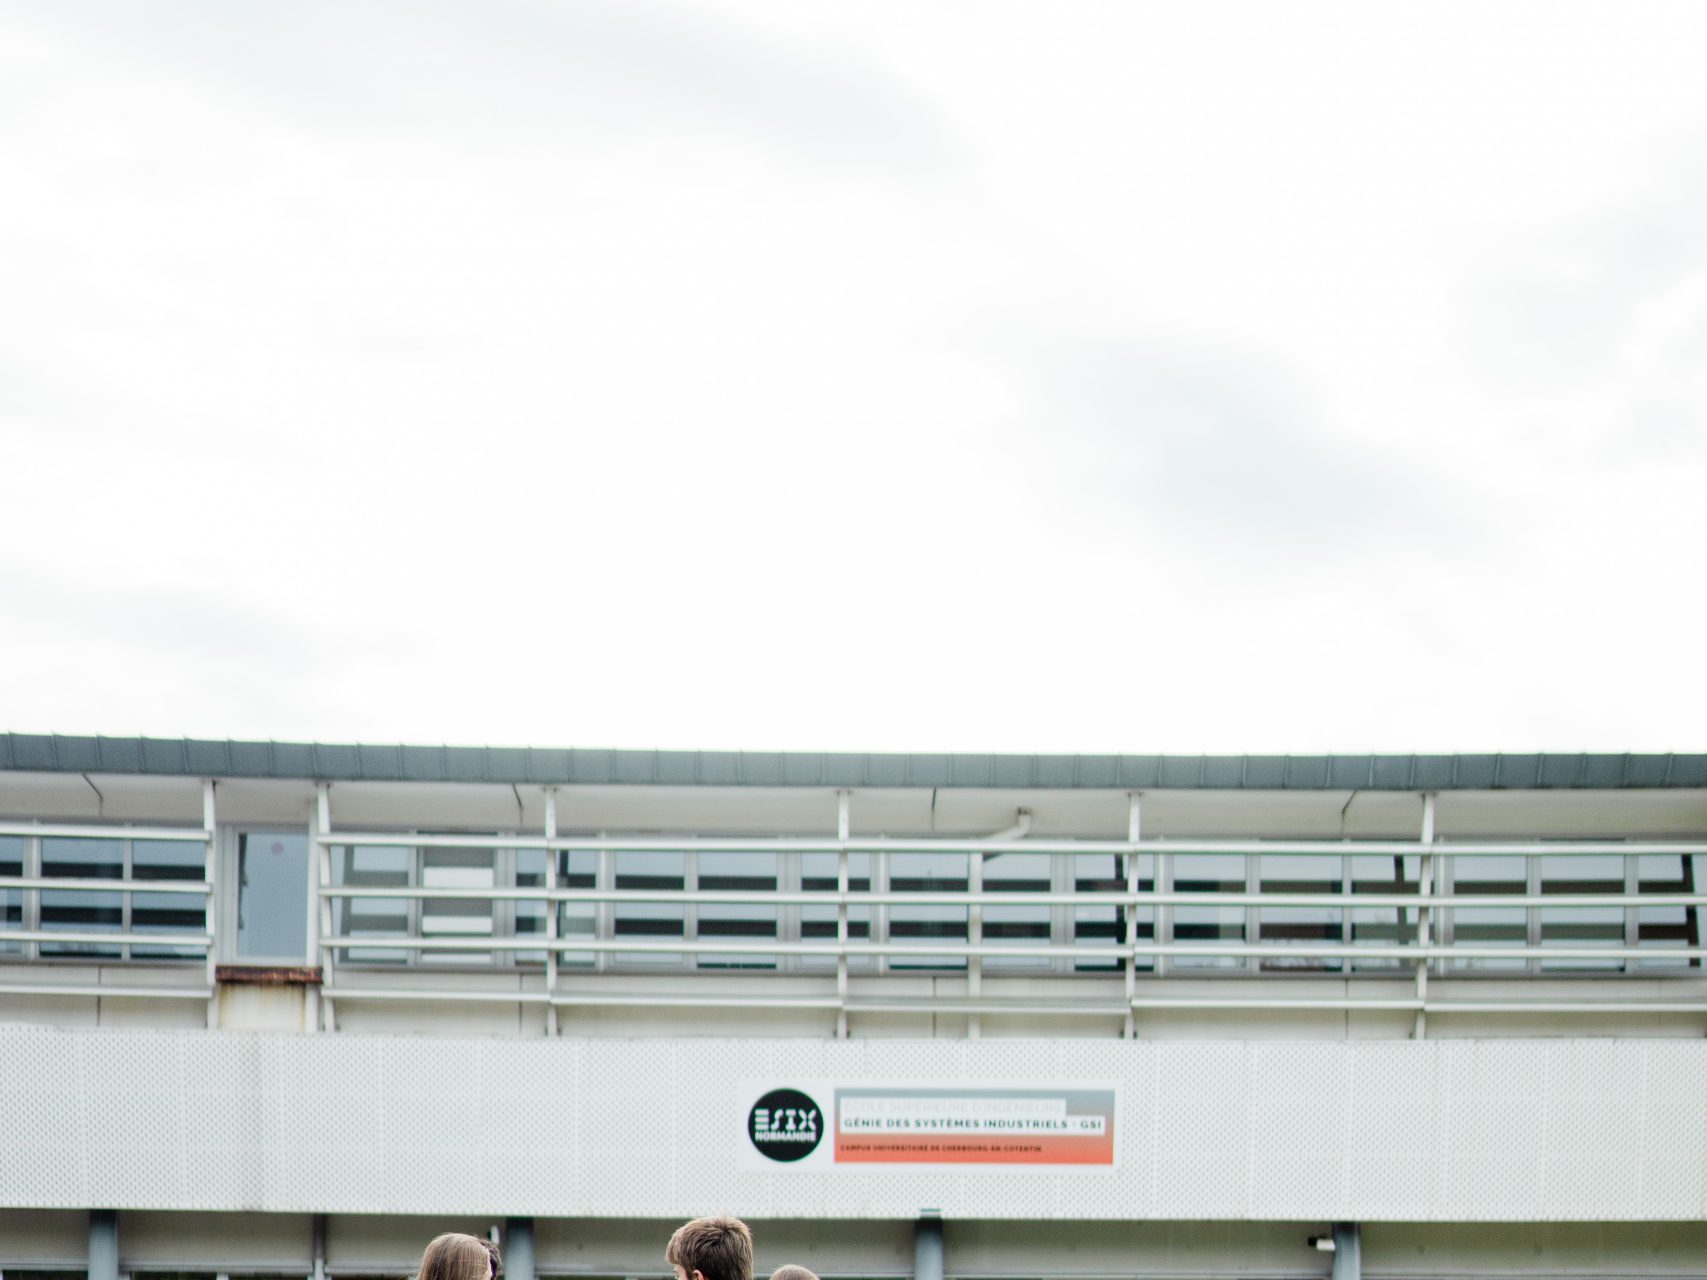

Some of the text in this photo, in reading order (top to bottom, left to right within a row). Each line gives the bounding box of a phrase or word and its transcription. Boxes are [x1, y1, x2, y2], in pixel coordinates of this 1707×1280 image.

[844, 1100, 885, 1113] ÉCOLE
[754, 1108, 817, 1131] ESIX
[844, 1116, 1102, 1129] GÉNIE DES SYSTÈMES INDUSTRIELS GSI
[754, 1131, 817, 1142] NORMANDIE
[840, 1144, 871, 1152] CAMPUS
[873, 1144, 928, 1152] UNIVERSITAIRE
